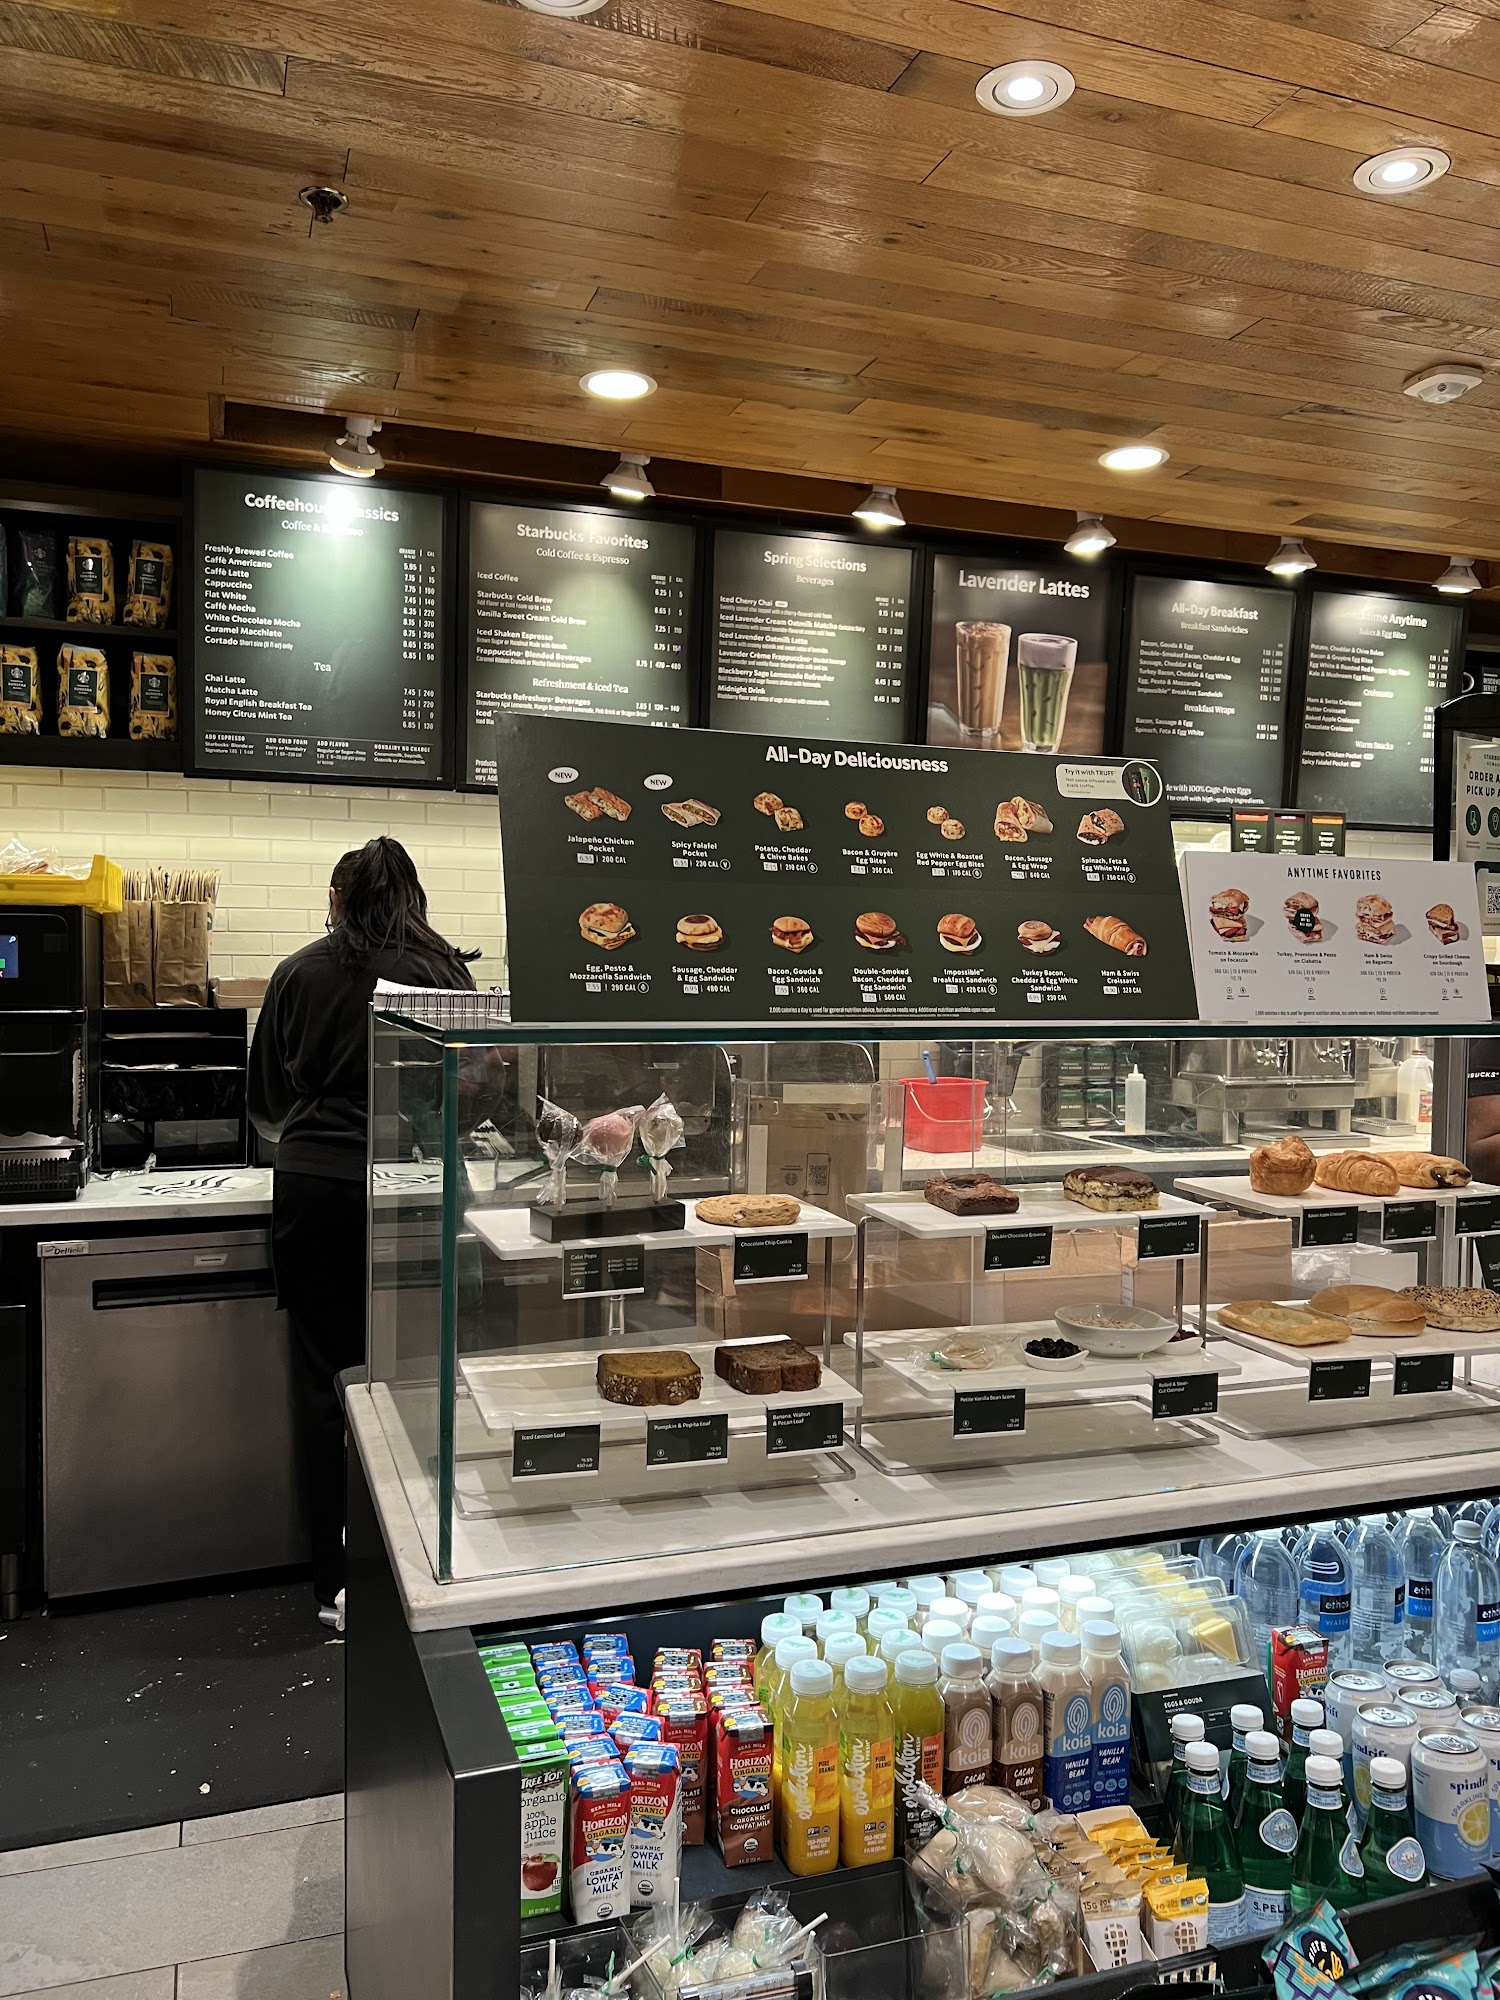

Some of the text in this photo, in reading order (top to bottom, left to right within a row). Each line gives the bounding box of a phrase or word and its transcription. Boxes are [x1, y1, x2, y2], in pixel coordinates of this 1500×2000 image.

[517, 524, 648, 549] Starbucks Favorites
[205, 544, 294, 559] Freshly Brewed Coffee
[536, 548, 555, 557] Cold
[557, 549, 584, 560] Coffee
[593, 555, 629, 565] Espresso
[228, 558, 272, 568] Americano
[764, 551, 867, 572] Spring Selections
[228, 569, 249, 578] Latte
[494, 574, 518, 582] Coffee
[205, 579, 252, 590] Cappuccino
[797, 575, 834, 587] Beverages
[959, 570, 1090, 598] Lavender Lattes
[205, 590, 246, 600] Flat White
[517, 593, 553, 604] Cold Brew
[735, 597, 757, 607] Cherry
[228, 604, 256, 612] Mocha
[1172, 602, 1258, 620] All-Day Breakfast
[205, 613, 301, 627] White Chocolate Mocha
[477, 610, 587, 625] Vanilla Sweet Cream Cold Brew
[1389, 614, 1427, 627] Anytime
[205, 625, 282, 637] Caramel Macchiato
[1181, 622, 1248, 634] Breakfast Sandwiches
[476, 628, 553, 641] Iced Shaken Espresso
[205, 636, 238, 645] Cortado
[314, 662, 332, 672] Tea
[205, 674, 245, 684] Chai Latte
[205, 686, 258, 696] Matcha Latte
[533, 678, 586, 691] Refreshment
[595, 683, 612, 692] Iced
[614, 684, 628, 693] Tea
[205, 697, 312, 711] Royal English Breakfast Tea
[205, 708, 292, 721] Honey Citrus Mint Tea
[766, 746, 948, 773] All-Day Deliciousness
[1469, 771, 1493, 782] ORDER
[1467, 785, 1496, 797] PICK UP
[568, 835, 634, 845] Jalapeño Chicken
[672, 841, 717, 850] Spicy Falafel
[589, 845, 615, 853] Pocket
[1287, 867, 1382, 881] ANYTIME FAVORITES
[570, 973, 651, 981] Mozzarella Sandwich
[685, 974, 698, 983] Egg
[741, 1240, 764, 1248] Chocolate
[654, 1423, 677, 1431] Pumpkin
[683, 1421, 699, 1430] Pepita
[554, 1431, 566, 1439] Loaf
[1325, 1600, 1349, 1609] ethos
[1184, 1697, 1203, 1705] GOUDA
[1098, 1723, 1127, 1738] koia
[1063, 1734, 1091, 1751] koia
[1010, 1743, 1039, 1759] koia
[1099, 1747, 1125, 1757] VANILLA
[730, 1754, 771, 1769] HORIZON
[958, 1750, 990, 1766] koia
[1102, 1757, 1120, 1766] BEAN
[818, 1765, 835, 1774] ORANGE
[1065, 1758, 1089, 1770] VANILLA
[734, 1767, 768, 1776] ORGANIC
[1014, 1767, 1034, 1778] CACAO
[1069, 1769, 1085, 1779] BEAN
[964, 1773, 985, 1784] CACAO
[1016, 1778, 1033, 1787] BEAN
[521, 1792, 566, 1807] organic
[591, 1805, 606, 1813] REAL
[731, 1803, 770, 1814] CHOCOLATE
[527, 1811, 546, 1820] 100%
[737, 1815, 766, 1823] ORGANIC
[525, 1816, 556, 1831] apple
[582, 1812, 628, 1832] HORIZON
[524, 1828, 556, 1844] juice
[587, 1828, 624, 1840] ORGANIC
[590, 1866, 621, 1876] ORGANIC
[587, 1871, 623, 1885] LOWFAT
[593, 1882, 618, 1895] MILK
